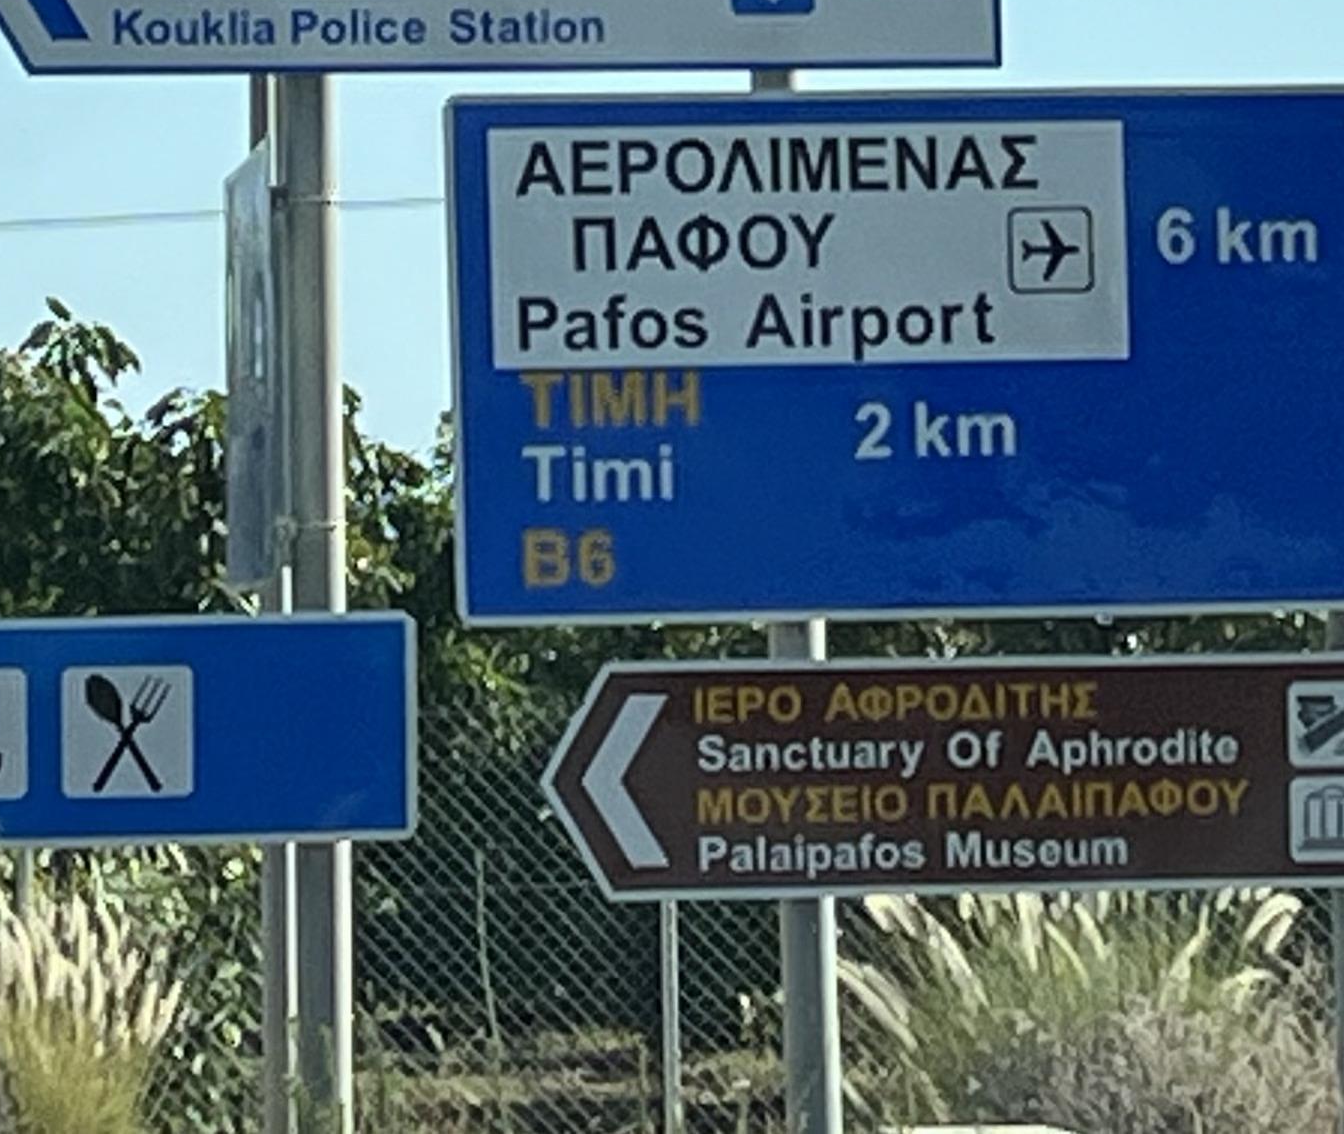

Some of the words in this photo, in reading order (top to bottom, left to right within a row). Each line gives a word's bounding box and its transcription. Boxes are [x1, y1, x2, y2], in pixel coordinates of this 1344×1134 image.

[112, 9, 276, 47] Kouklia
[290, 7, 426, 46] Police
[450, 8, 605, 45] Station
[516, 135, 1040, 198] ΑΕΡΟΛΙΜΕΝΑΣ
[572, 213, 836, 273] ΠΑΦΟΥ
[1157, 208, 1194, 263] 6
[1217, 206, 1319, 263] km
[518, 296, 709, 353] Pafos
[747, 292, 996, 363] Airport
[520, 372, 701, 429] ΤΙΜΗ
[854, 402, 893, 461] 2
[913, 401, 1019, 458] km
[522, 443, 674, 502] Timi
[522, 528, 617, 590] B6
[693, 686, 803, 725] ΙΕΡΟ
[823, 681, 1099, 723] ΑΦΡΟΔΙΤΗΣ
[696, 733, 925, 778] Sanctuary
[946, 731, 1002, 767] Of
[1027, 729, 1241, 774] Aphrodite
[695, 783, 909, 826] ΜΟΥΣΕΙΟ
[926, 777, 1252, 821] ΠΑΛΑΙΠΑΦΟΥ
[698, 832, 926, 878] Palaipafos
[946, 831, 1130, 869] Museum
